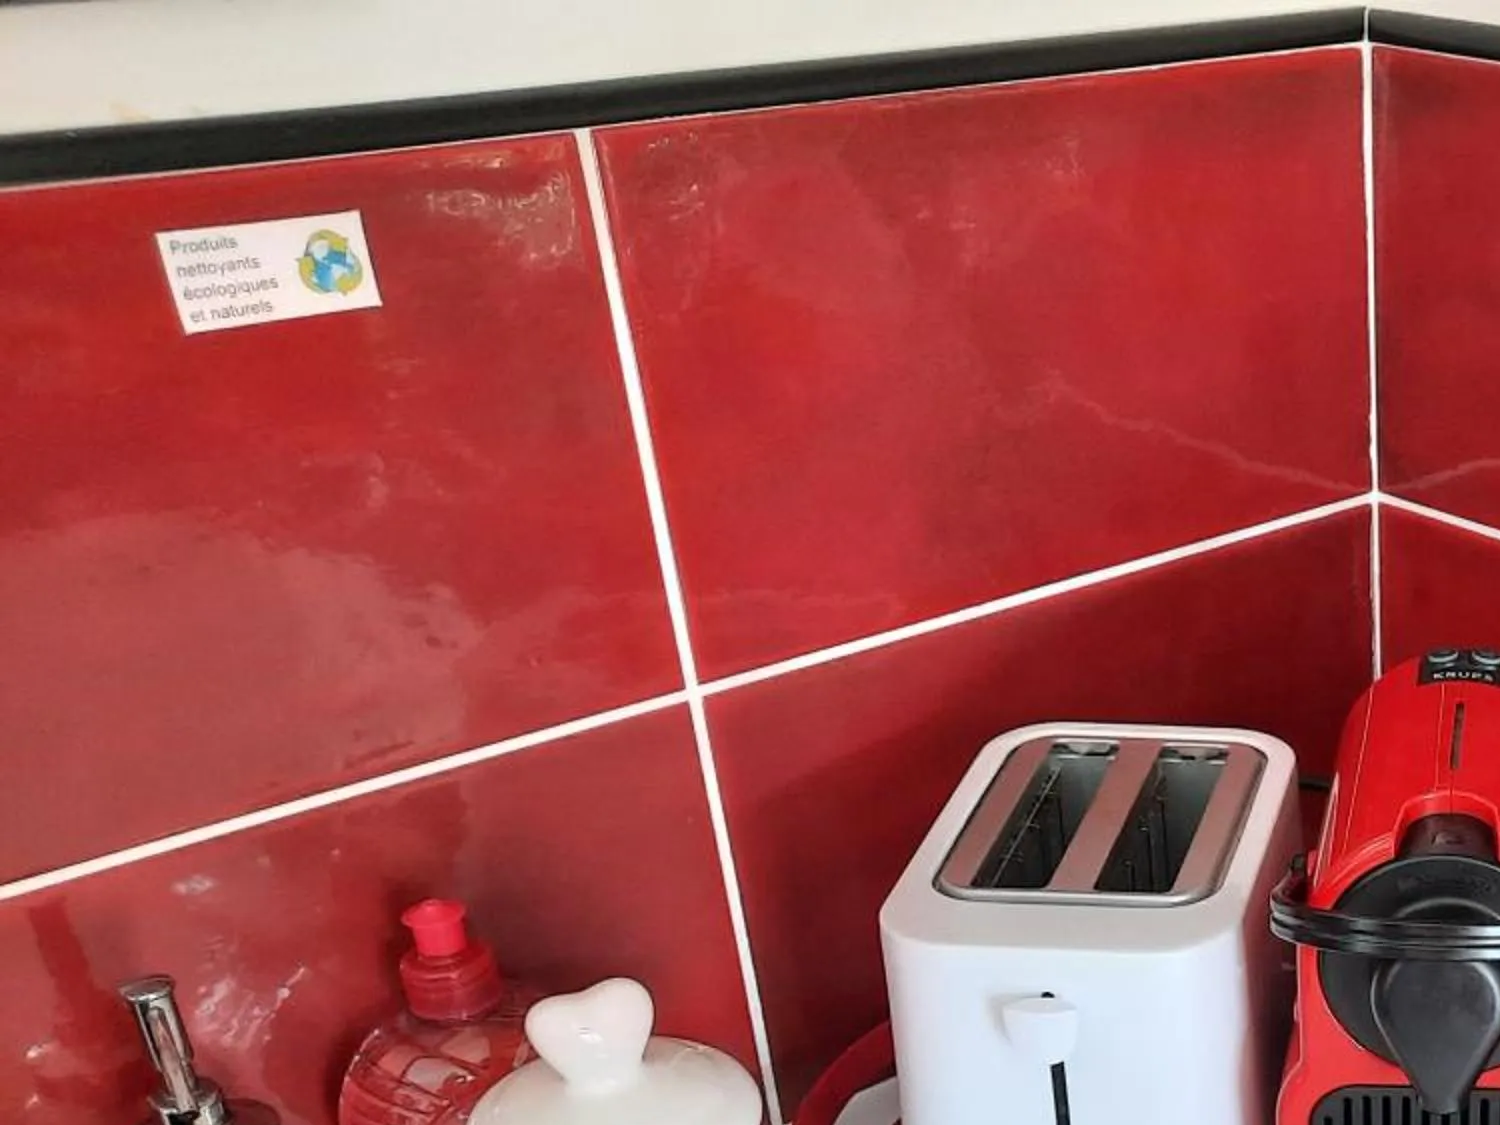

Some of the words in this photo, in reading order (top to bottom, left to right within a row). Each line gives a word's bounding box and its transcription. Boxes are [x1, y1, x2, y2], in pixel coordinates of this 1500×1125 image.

[169, 235, 239, 255] Produits
[176, 256, 261, 278] nettoyants
[183, 275, 279, 300] écologiques
[190, 309, 206, 323] et
[211, 299, 274, 321] naturels
